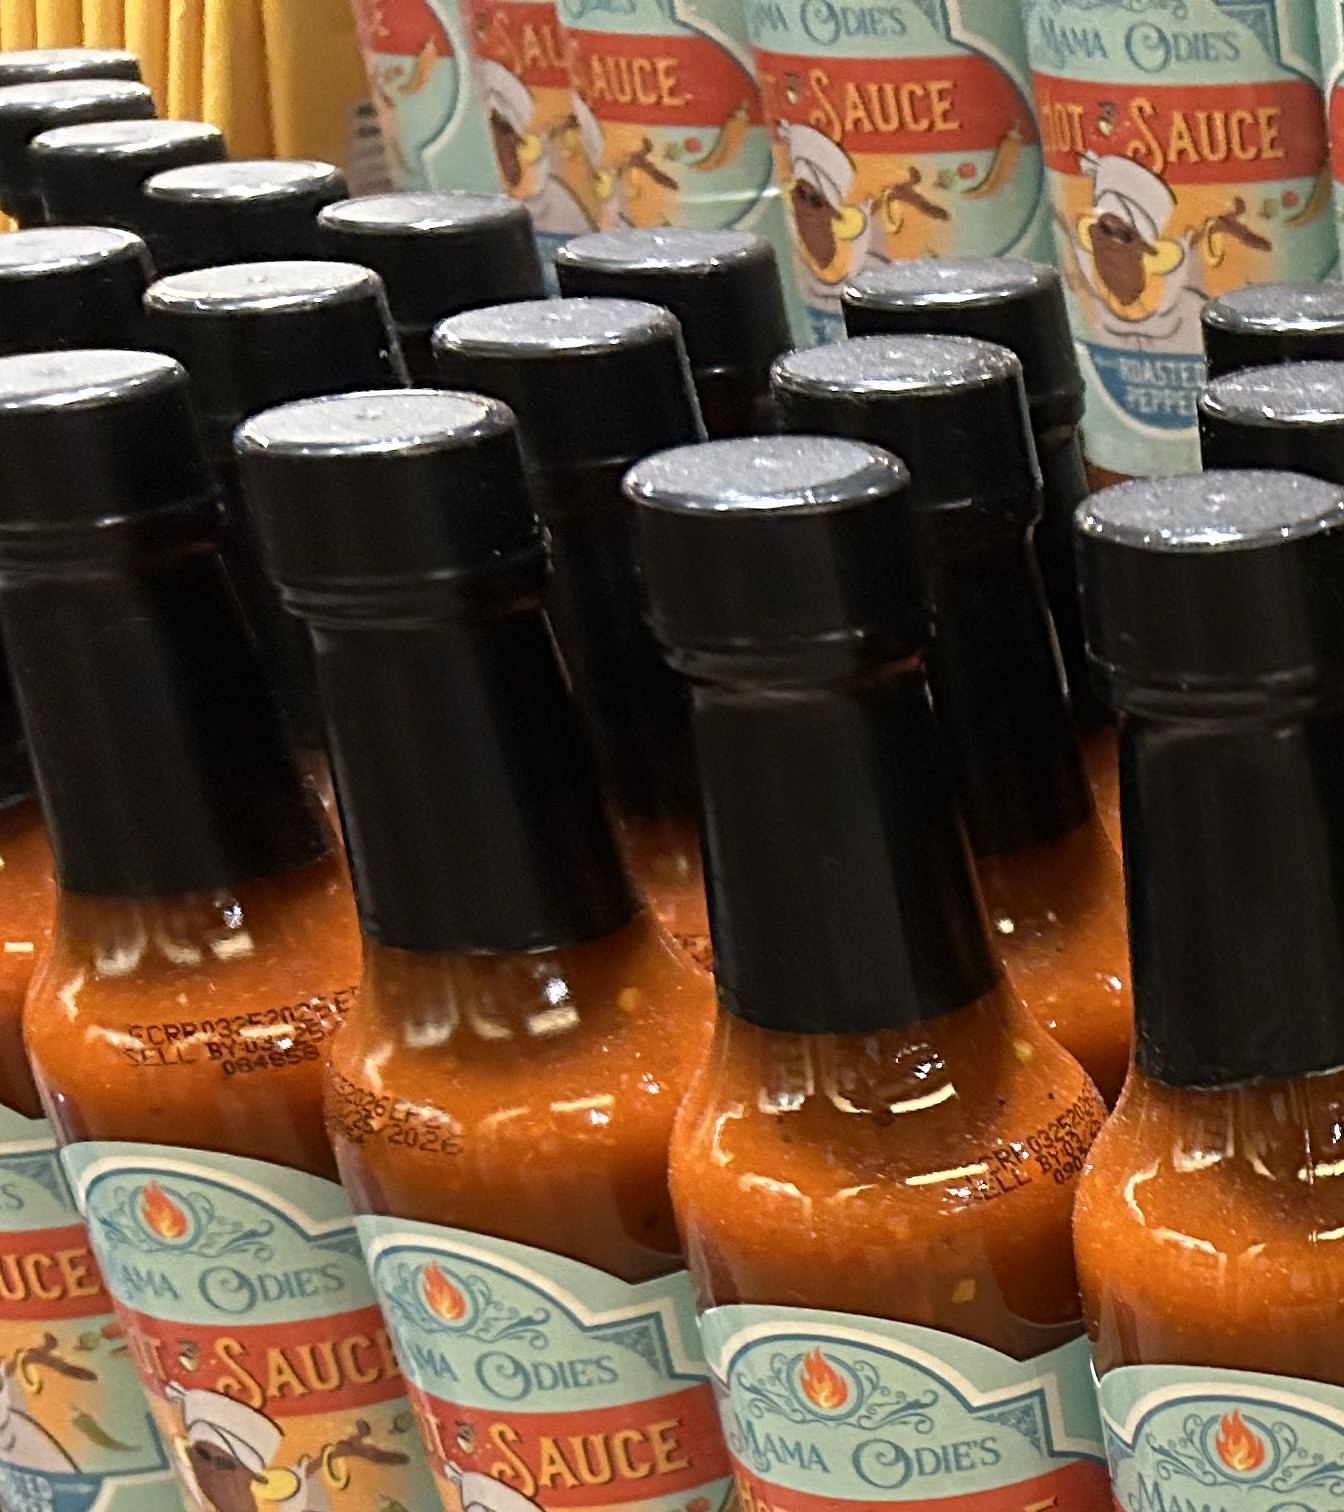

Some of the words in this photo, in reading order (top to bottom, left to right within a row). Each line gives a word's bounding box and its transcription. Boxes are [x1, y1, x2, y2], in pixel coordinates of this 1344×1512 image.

[809, 67, 962, 144] SAUCE
[1126, 97, 1285, 175] SAUCE
[1126, 386, 1198, 416] PEPPE
[0, 1248, 99, 1302] UCE
[488, 1418, 692, 1499] SAUCE
[731, 1416, 830, 1474] MAMA
[851, 1436, 1001, 1490] ODIE'S
